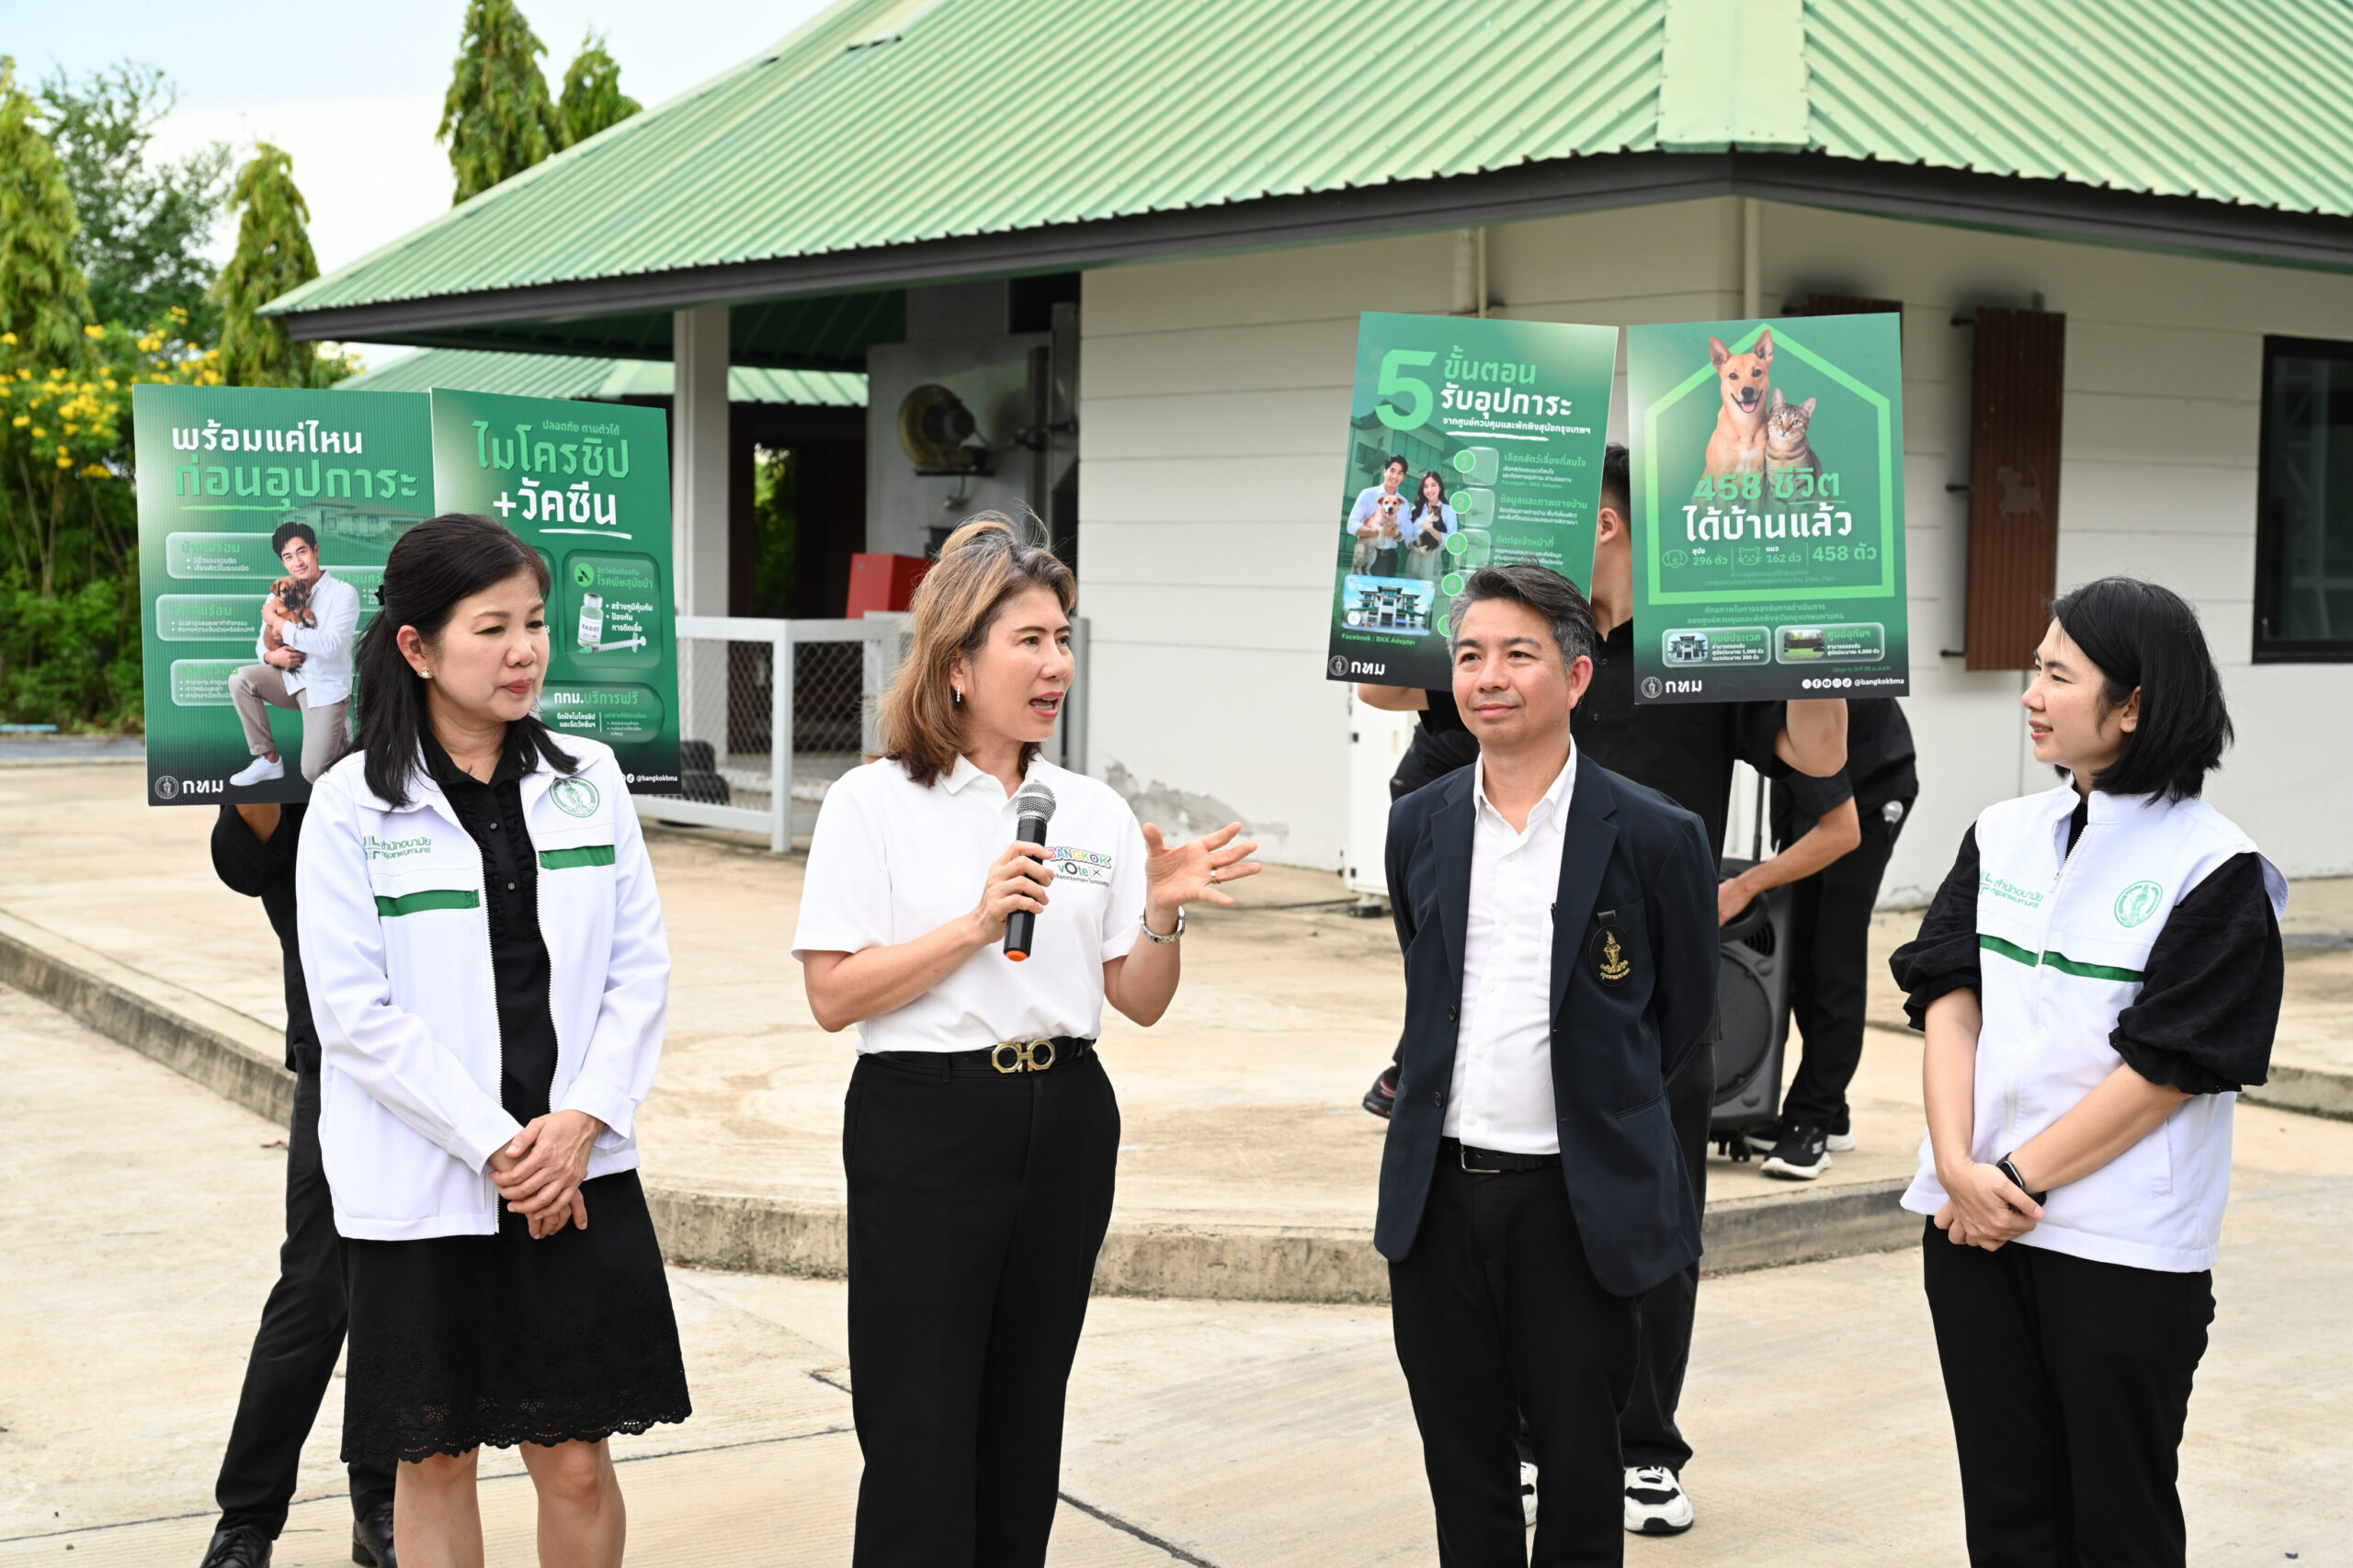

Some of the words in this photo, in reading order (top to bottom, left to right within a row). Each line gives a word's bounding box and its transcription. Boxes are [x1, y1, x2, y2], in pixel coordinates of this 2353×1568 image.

[1444, 346, 1536, 384] ขั้นตอน
[1375, 349, 1437, 431] 5
[1440, 382, 1573, 419] รับอุปการะ
[542, 419, 580, 432] ปลอดภัย
[581, 423, 620, 436] ตามตัวได้
[172, 419, 363, 454] พร้อมแค่ไหน
[472, 420, 630, 478] ไมโครชิป
[1504, 452, 1587, 467] เลือกสัตว์เลี้ยงที่สนใจ
[175, 454, 418, 508] ก่อนอุปการะ
[1694, 474, 1762, 501] 458
[1773, 467, 1840, 497] ชีวิต
[493, 476, 617, 525] +วัคซีน
[1682, 502, 1852, 541] ได้บ้านแล้ว
[181, 540, 241, 553] บ้านพร้อม
[1495, 535, 1555, 548] ติดต่อเจ้าหน้าที่
[1693, 557, 1712, 566] 296
[1715, 554, 1728, 566] ตัว
[1766, 554, 1786, 564] 162
[1788, 552, 1802, 563] ตัว
[1812, 545, 1848, 562] 458
[1854, 542, 1878, 561] ตัว
[597, 574, 654, 590] โรคพิษสุนัขบ้า
[611, 611, 633, 620] ป้องกัน
[1341, 632, 1371, 642] Facebook
[1351, 661, 1386, 676] กทม
[1665, 680, 1702, 694] กทม
[1855, 676, 1904, 687] @bangkokbma
[182, 779, 223, 794] กทม
[636, 775, 678, 783] @bangkokbma
[1046, 847, 1110, 868] BANGKOK
